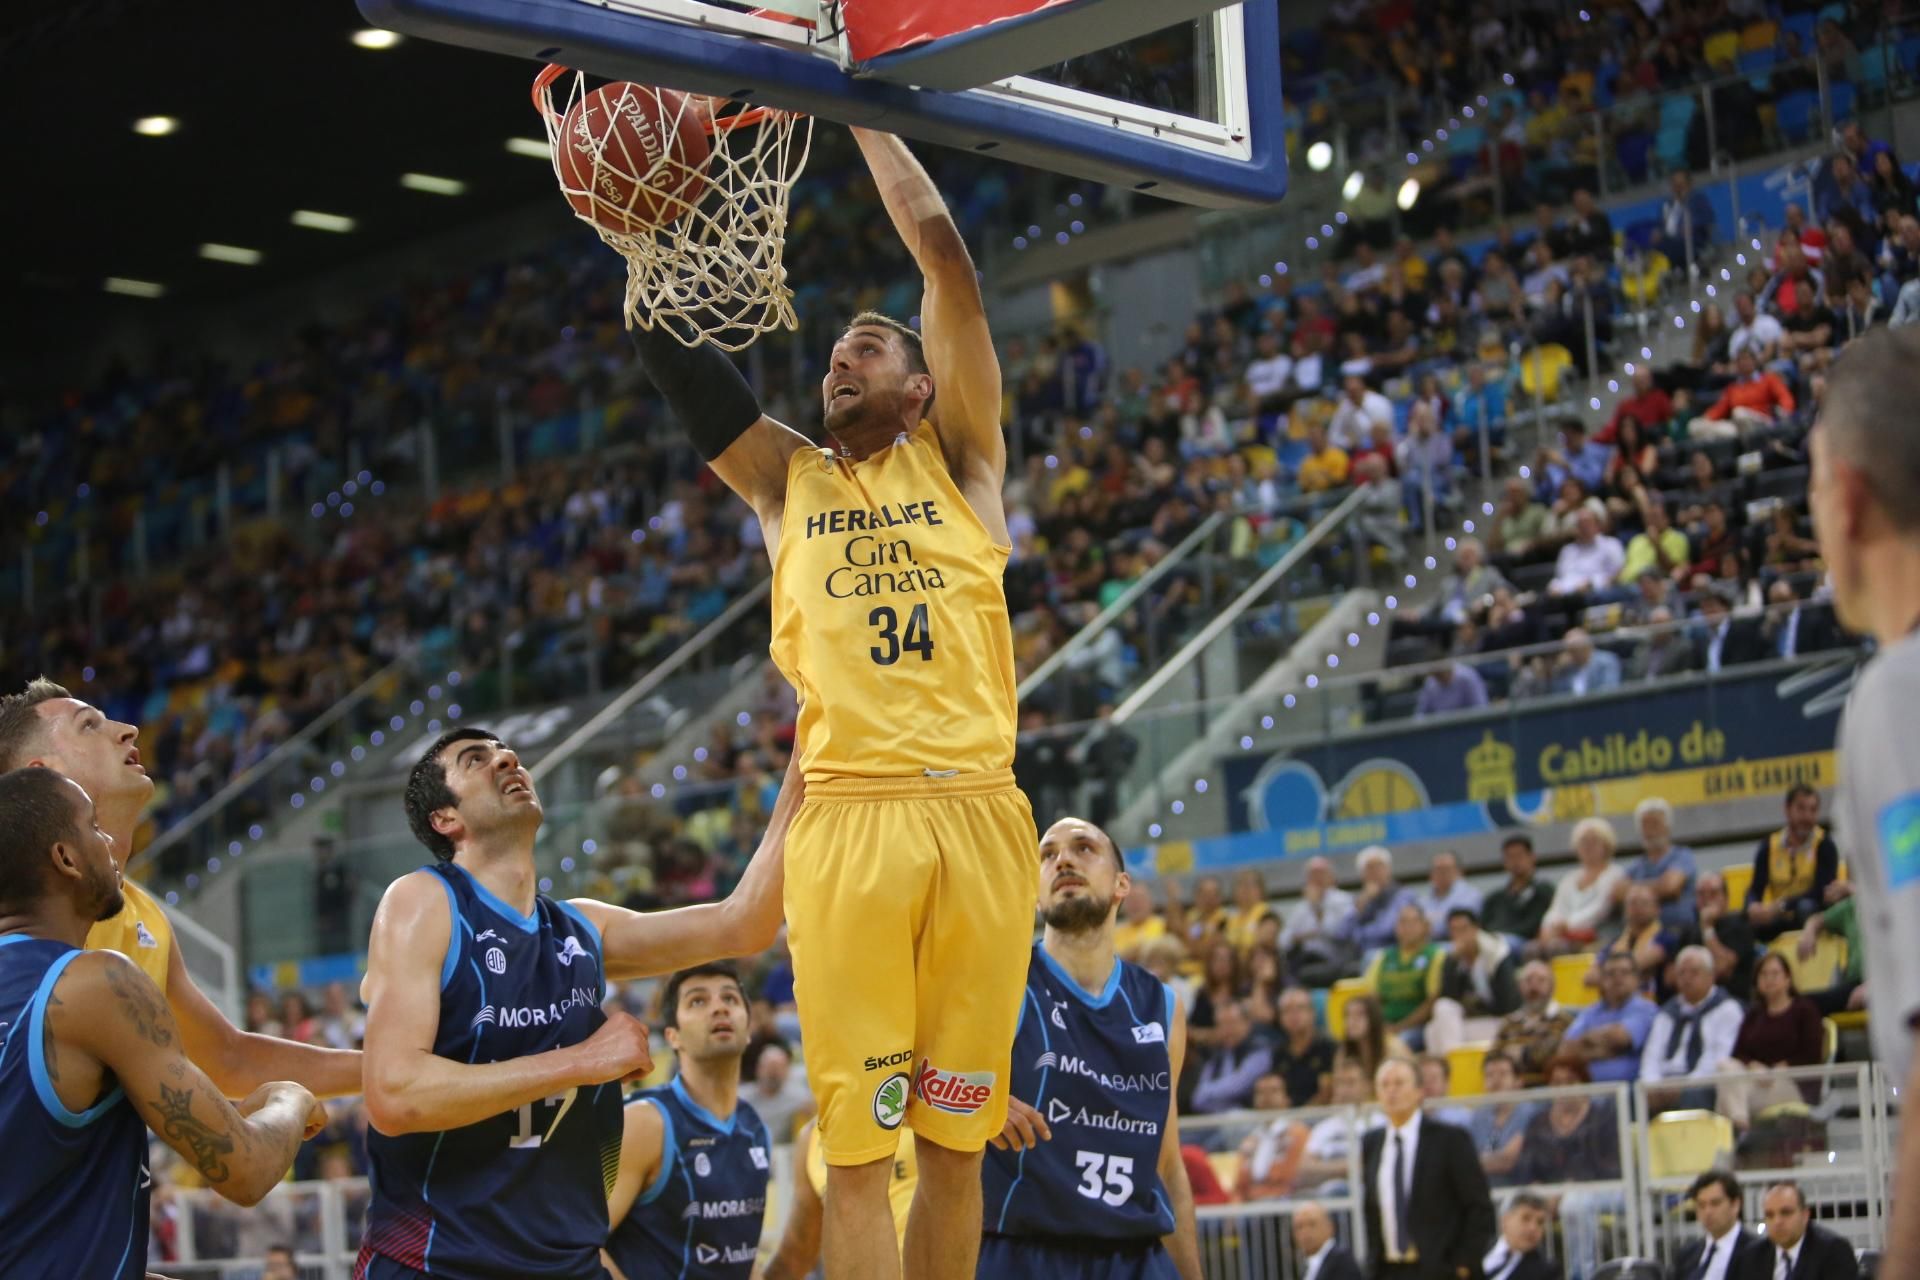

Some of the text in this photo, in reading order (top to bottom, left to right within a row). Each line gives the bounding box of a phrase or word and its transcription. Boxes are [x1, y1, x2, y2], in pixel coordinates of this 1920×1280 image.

[868, 603, 934, 666] 34
[1539, 721, 1726, 783] Cabildo de
[864, 1050, 914, 1072] ŠKOD
[914, 1057, 991, 1106] Kalise
[1072, 1106, 1158, 1136] Andorra
[1075, 1149, 1135, 1208] 35
